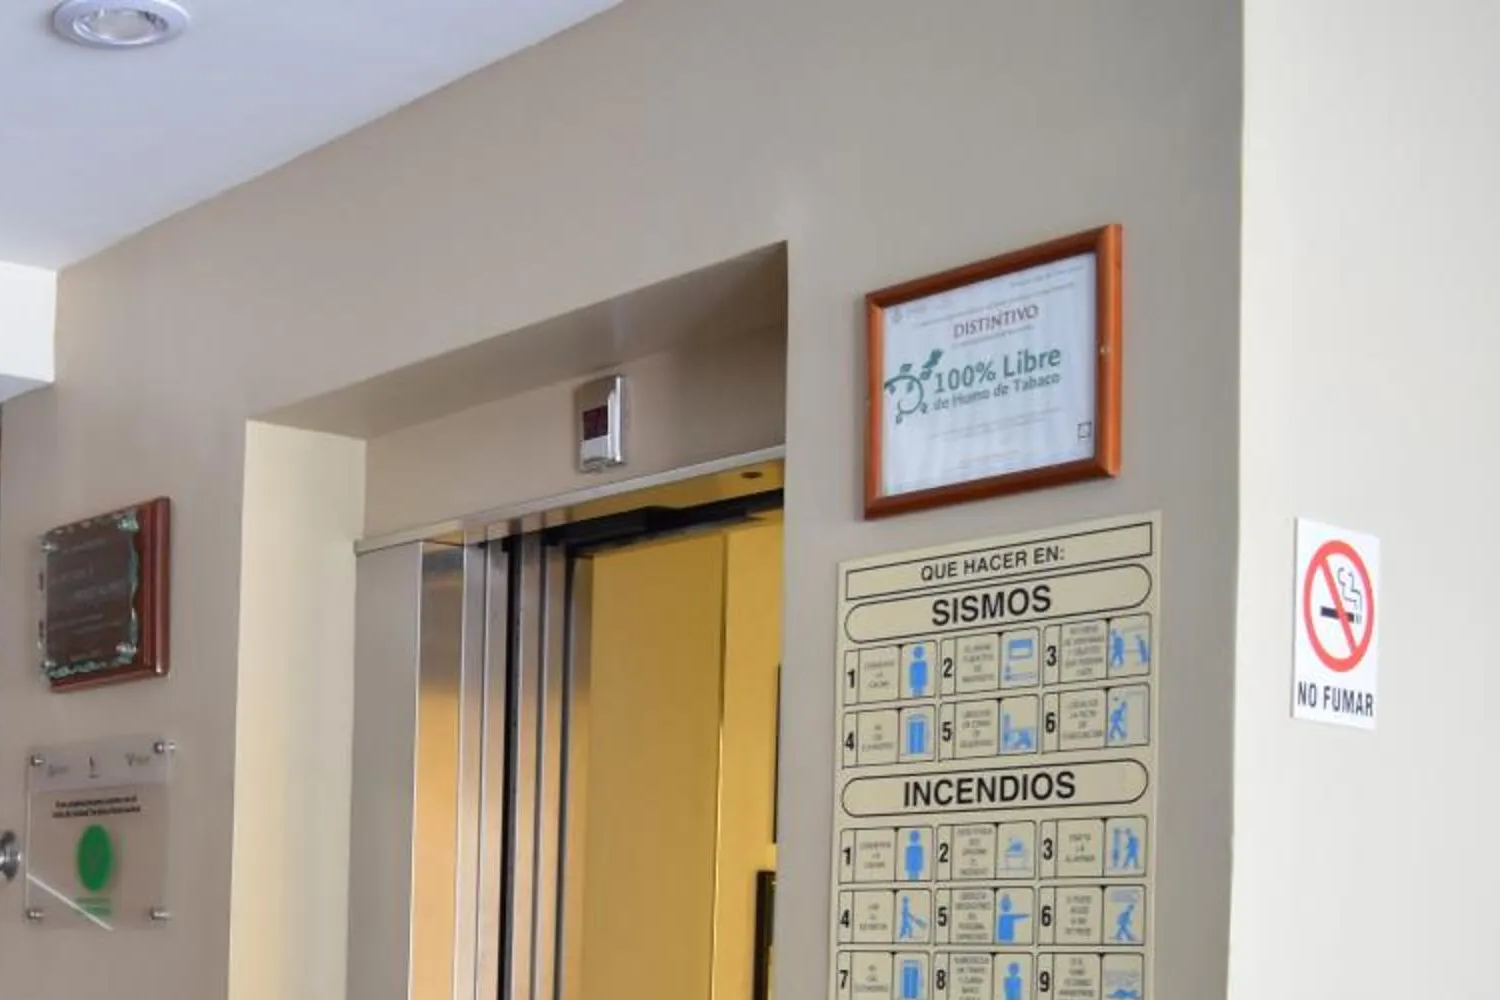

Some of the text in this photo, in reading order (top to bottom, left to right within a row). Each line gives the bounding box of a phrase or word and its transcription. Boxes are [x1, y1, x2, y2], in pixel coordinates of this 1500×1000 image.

[952, 304, 1040, 340] DISTINTIVO
[934, 348, 1061, 394] 100% Libre
[920, 546, 1065, 582] QUE HACER EN:
[931, 584, 1052, 627] SISMOS
[1046, 645, 1057, 667] 3
[847, 669, 855, 689] 1
[943, 657, 953, 679] 2
[1297, 681, 1374, 717] NO FUMAR
[941, 721, 952, 742] 5
[1045, 712, 1056, 733] 6
[845, 731, 855, 751] 4
[903, 771, 1076, 808] INCENDIOS
[842, 846, 851, 866] 1
[938, 842, 949, 863] 2
[1043, 838, 1053, 860] 3
[840, 908, 850, 928] 4
[937, 906, 948, 927] 5
[1041, 905, 1052, 927] 6
[839, 968, 849, 989] 7
[936, 968, 947, 990] 8
[1039, 970, 1050, 993] 9
